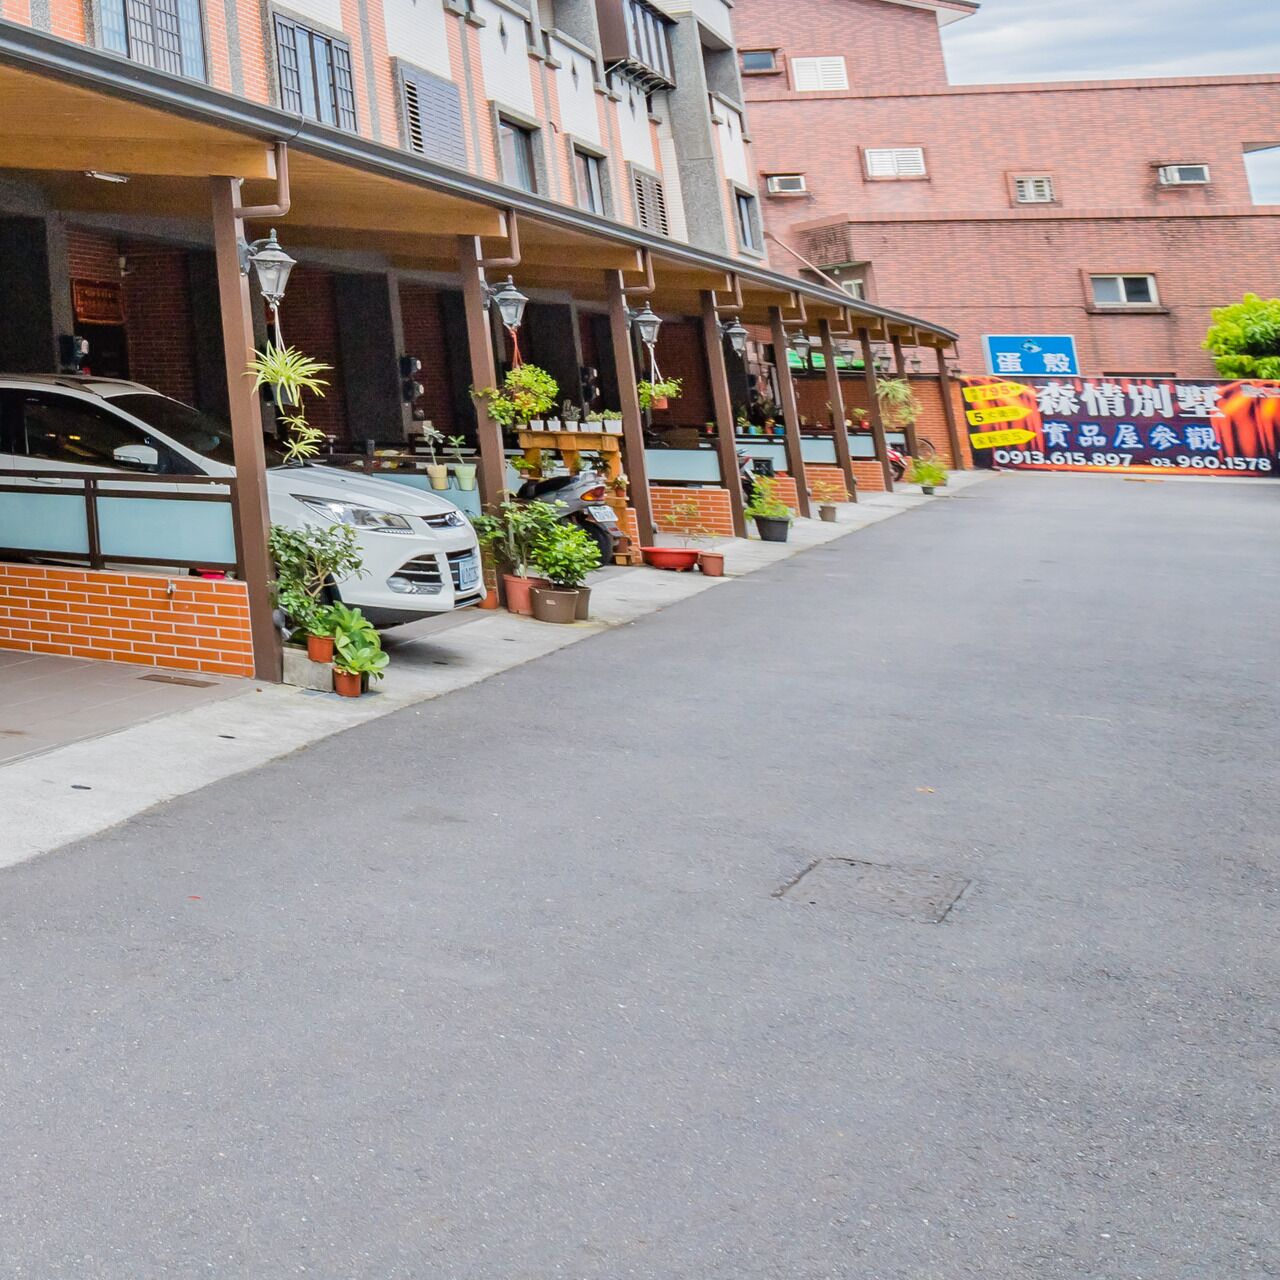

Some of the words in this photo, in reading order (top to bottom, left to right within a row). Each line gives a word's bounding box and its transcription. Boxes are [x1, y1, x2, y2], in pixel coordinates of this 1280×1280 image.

[1035, 382, 1226, 418] 森情別墅
[993, 450, 1133, 467] 0913.615.897
